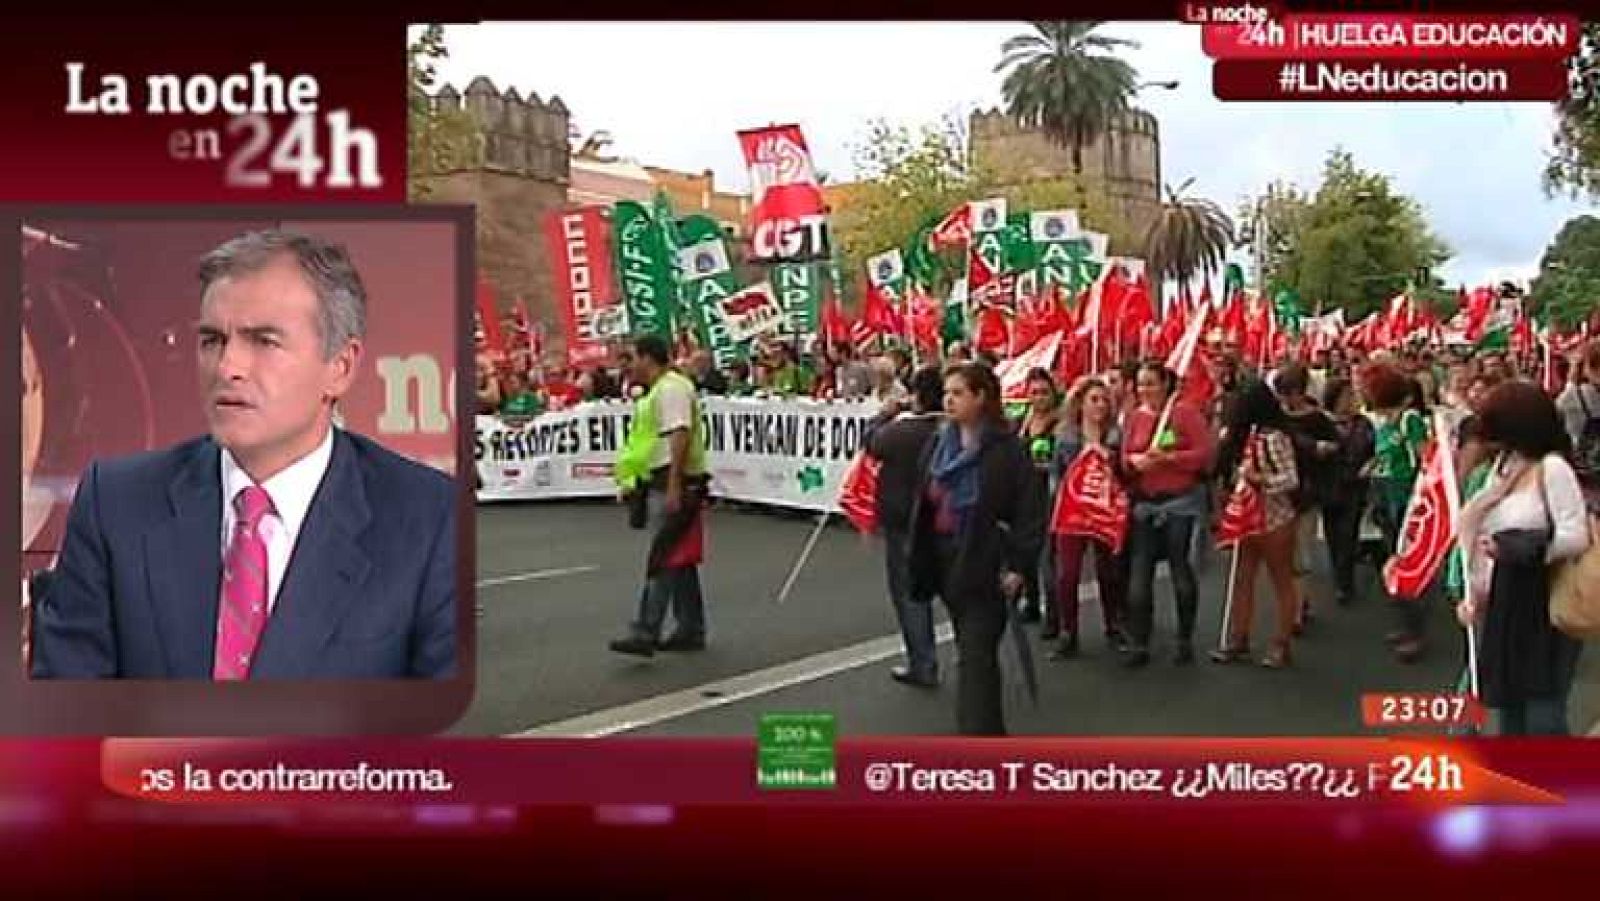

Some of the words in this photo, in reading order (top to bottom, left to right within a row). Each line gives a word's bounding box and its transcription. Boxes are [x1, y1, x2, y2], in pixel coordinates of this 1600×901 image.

[754, 214, 824, 257] CGT
[376, 354, 456, 434] n
[589, 415, 616, 451] EN
[804, 416, 826, 459] DE
